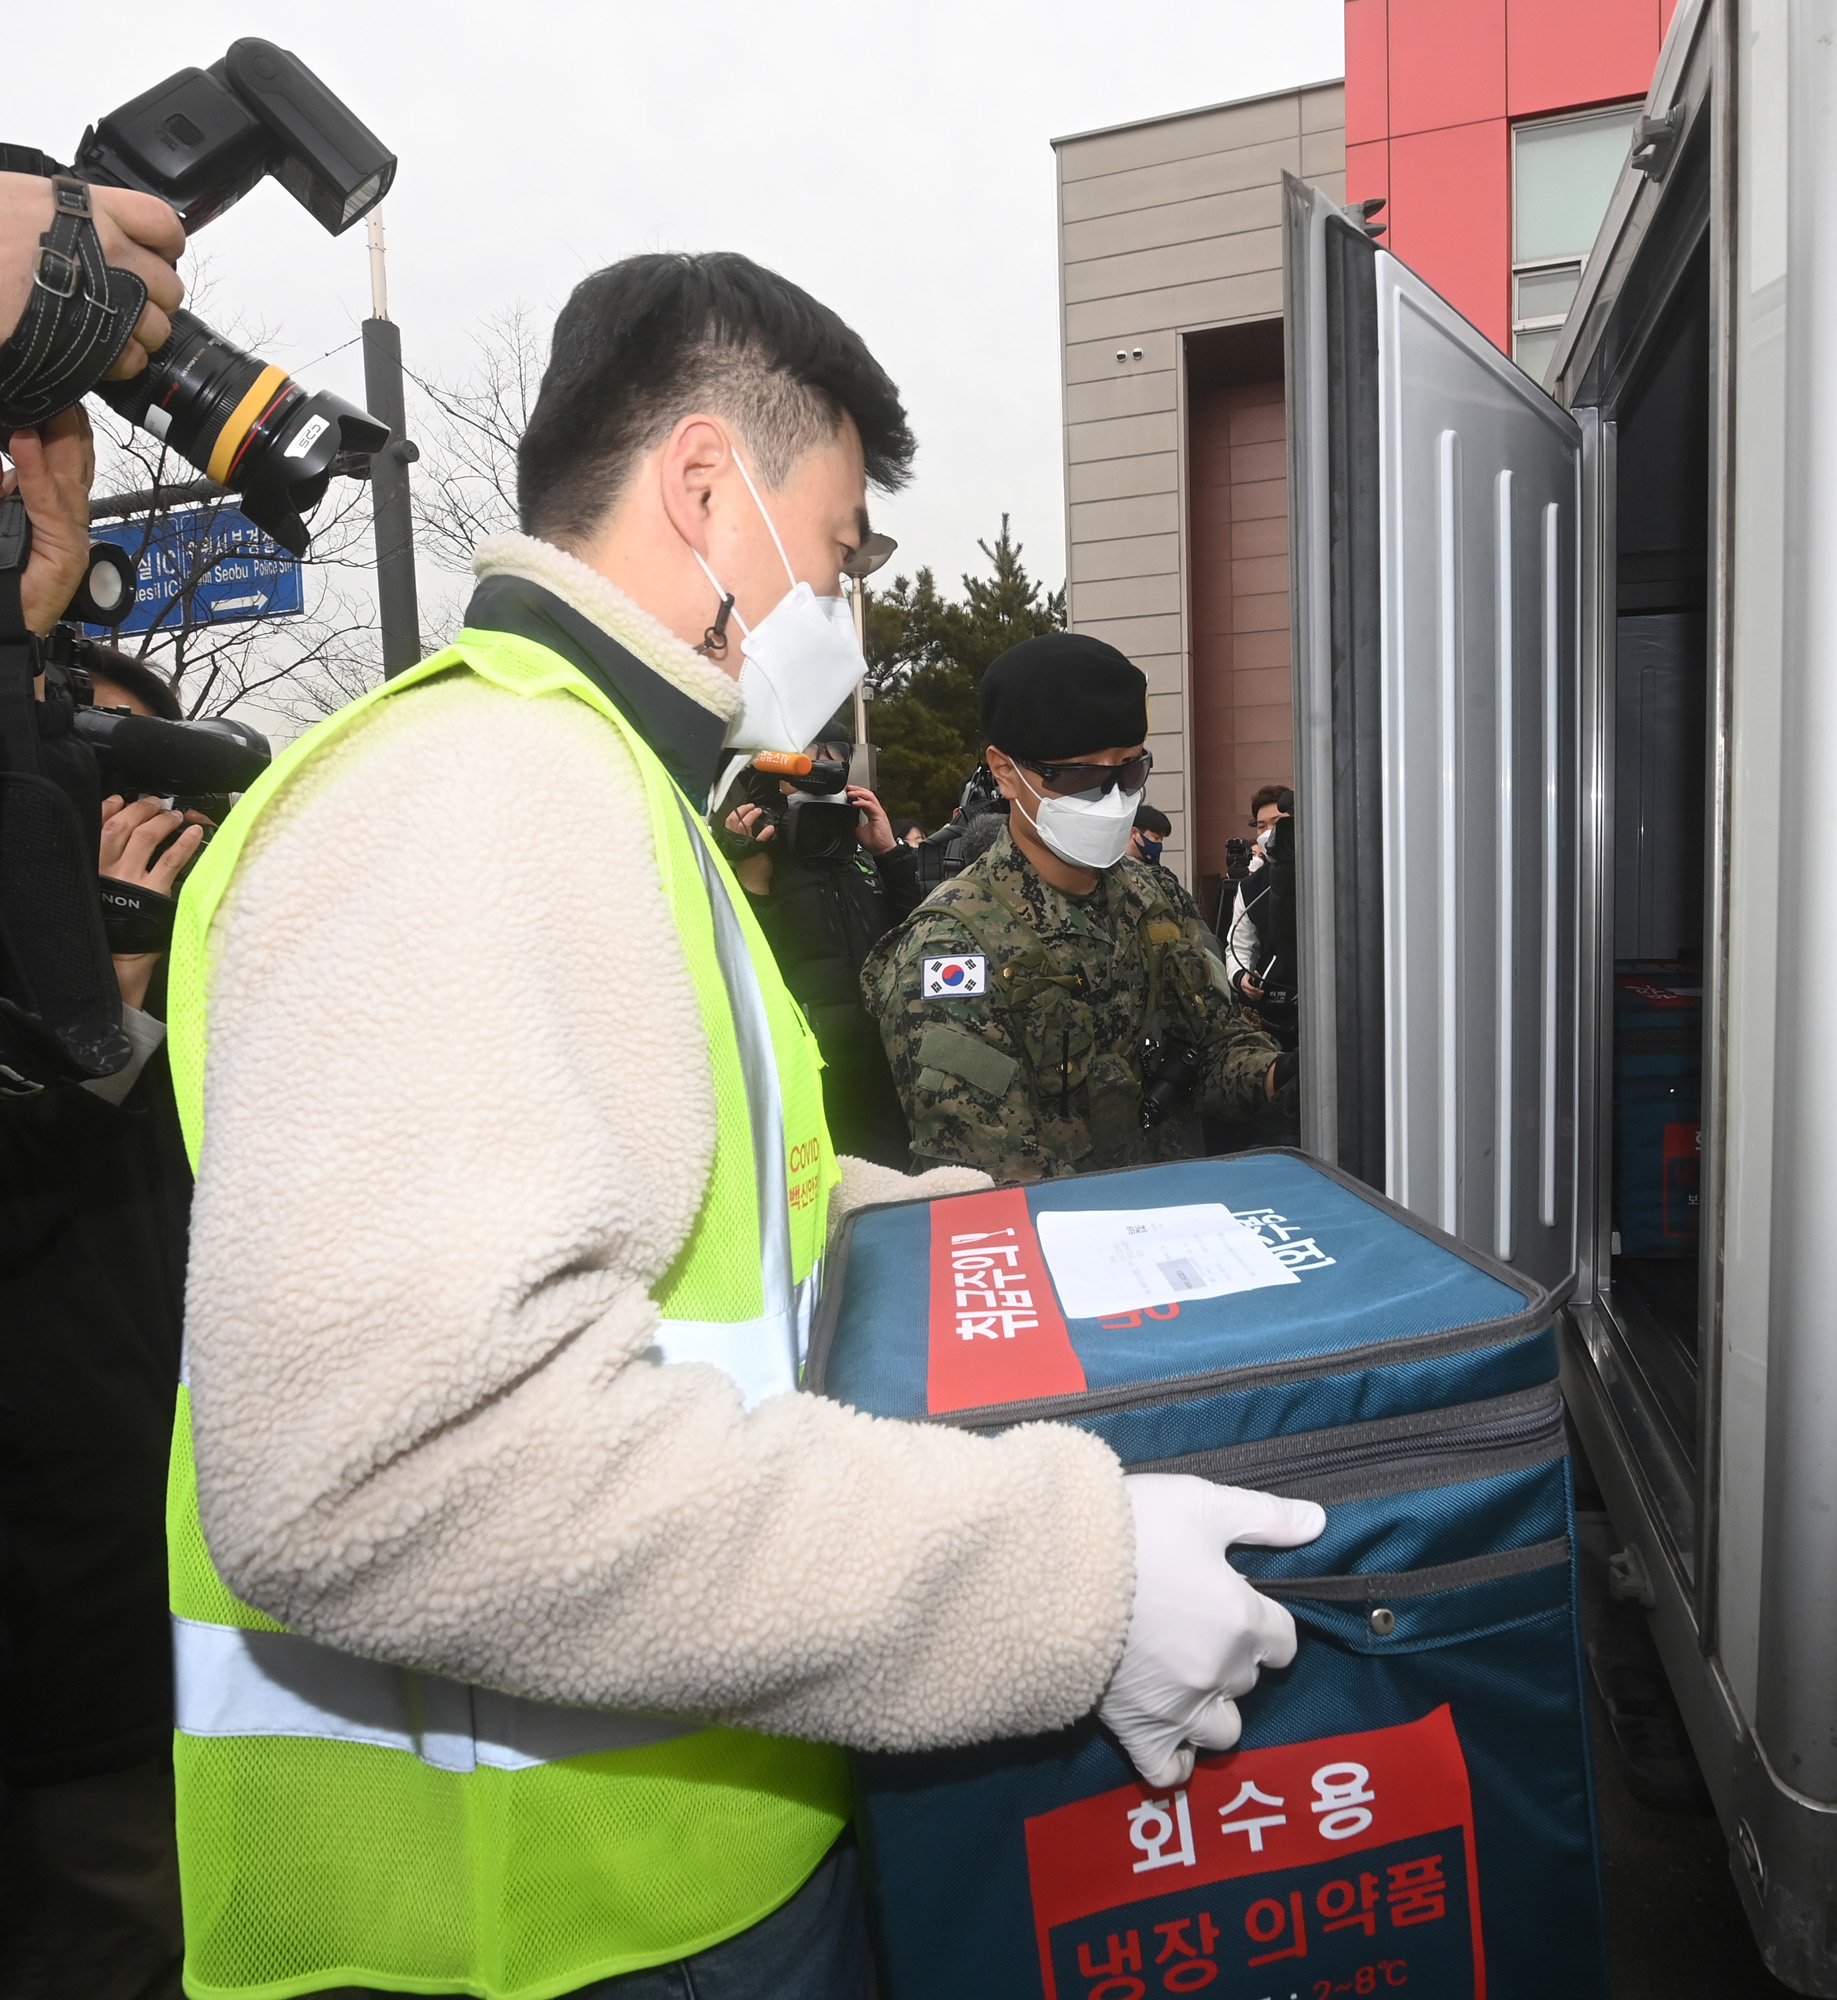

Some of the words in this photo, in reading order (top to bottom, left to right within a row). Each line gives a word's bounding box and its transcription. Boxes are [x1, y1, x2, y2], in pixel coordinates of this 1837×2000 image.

[214, 563, 249, 583] Seobu
[254, 559, 278, 577] Police
[164, 579, 179, 598] IC
[757, 750, 792, 765] 합뉴스TV
[101, 892, 140, 909] NON
[951, 1244, 1039, 1341] 취급주의
[1126, 1761, 1376, 1874] 회수용
[1077, 1912, 1220, 2000] 냉장
[1243, 1854, 1446, 1969] 의약품
